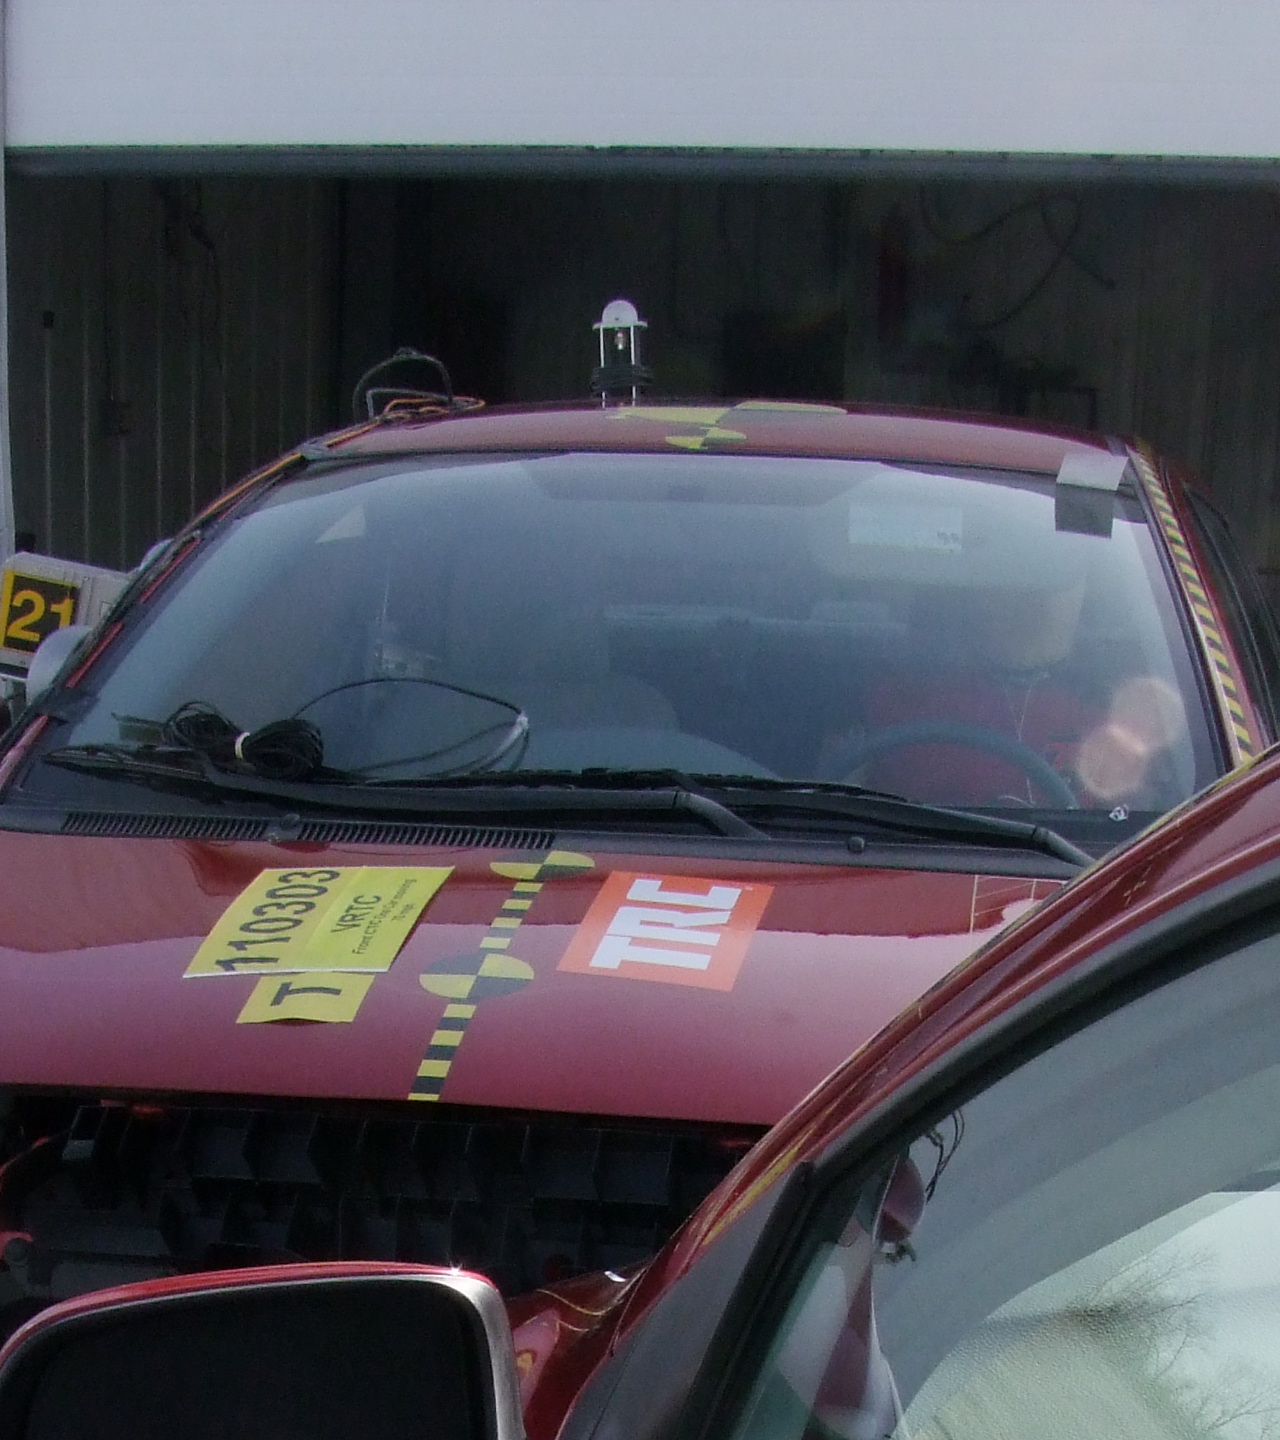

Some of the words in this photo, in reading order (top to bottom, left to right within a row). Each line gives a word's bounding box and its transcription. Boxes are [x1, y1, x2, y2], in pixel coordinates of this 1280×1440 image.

[6, 589, 76, 642] 21
[215, 869, 341, 972] 110303
[330, 894, 382, 933] VRTC
[588, 878, 742, 971] TRC
[270, 981, 342, 1007] T
